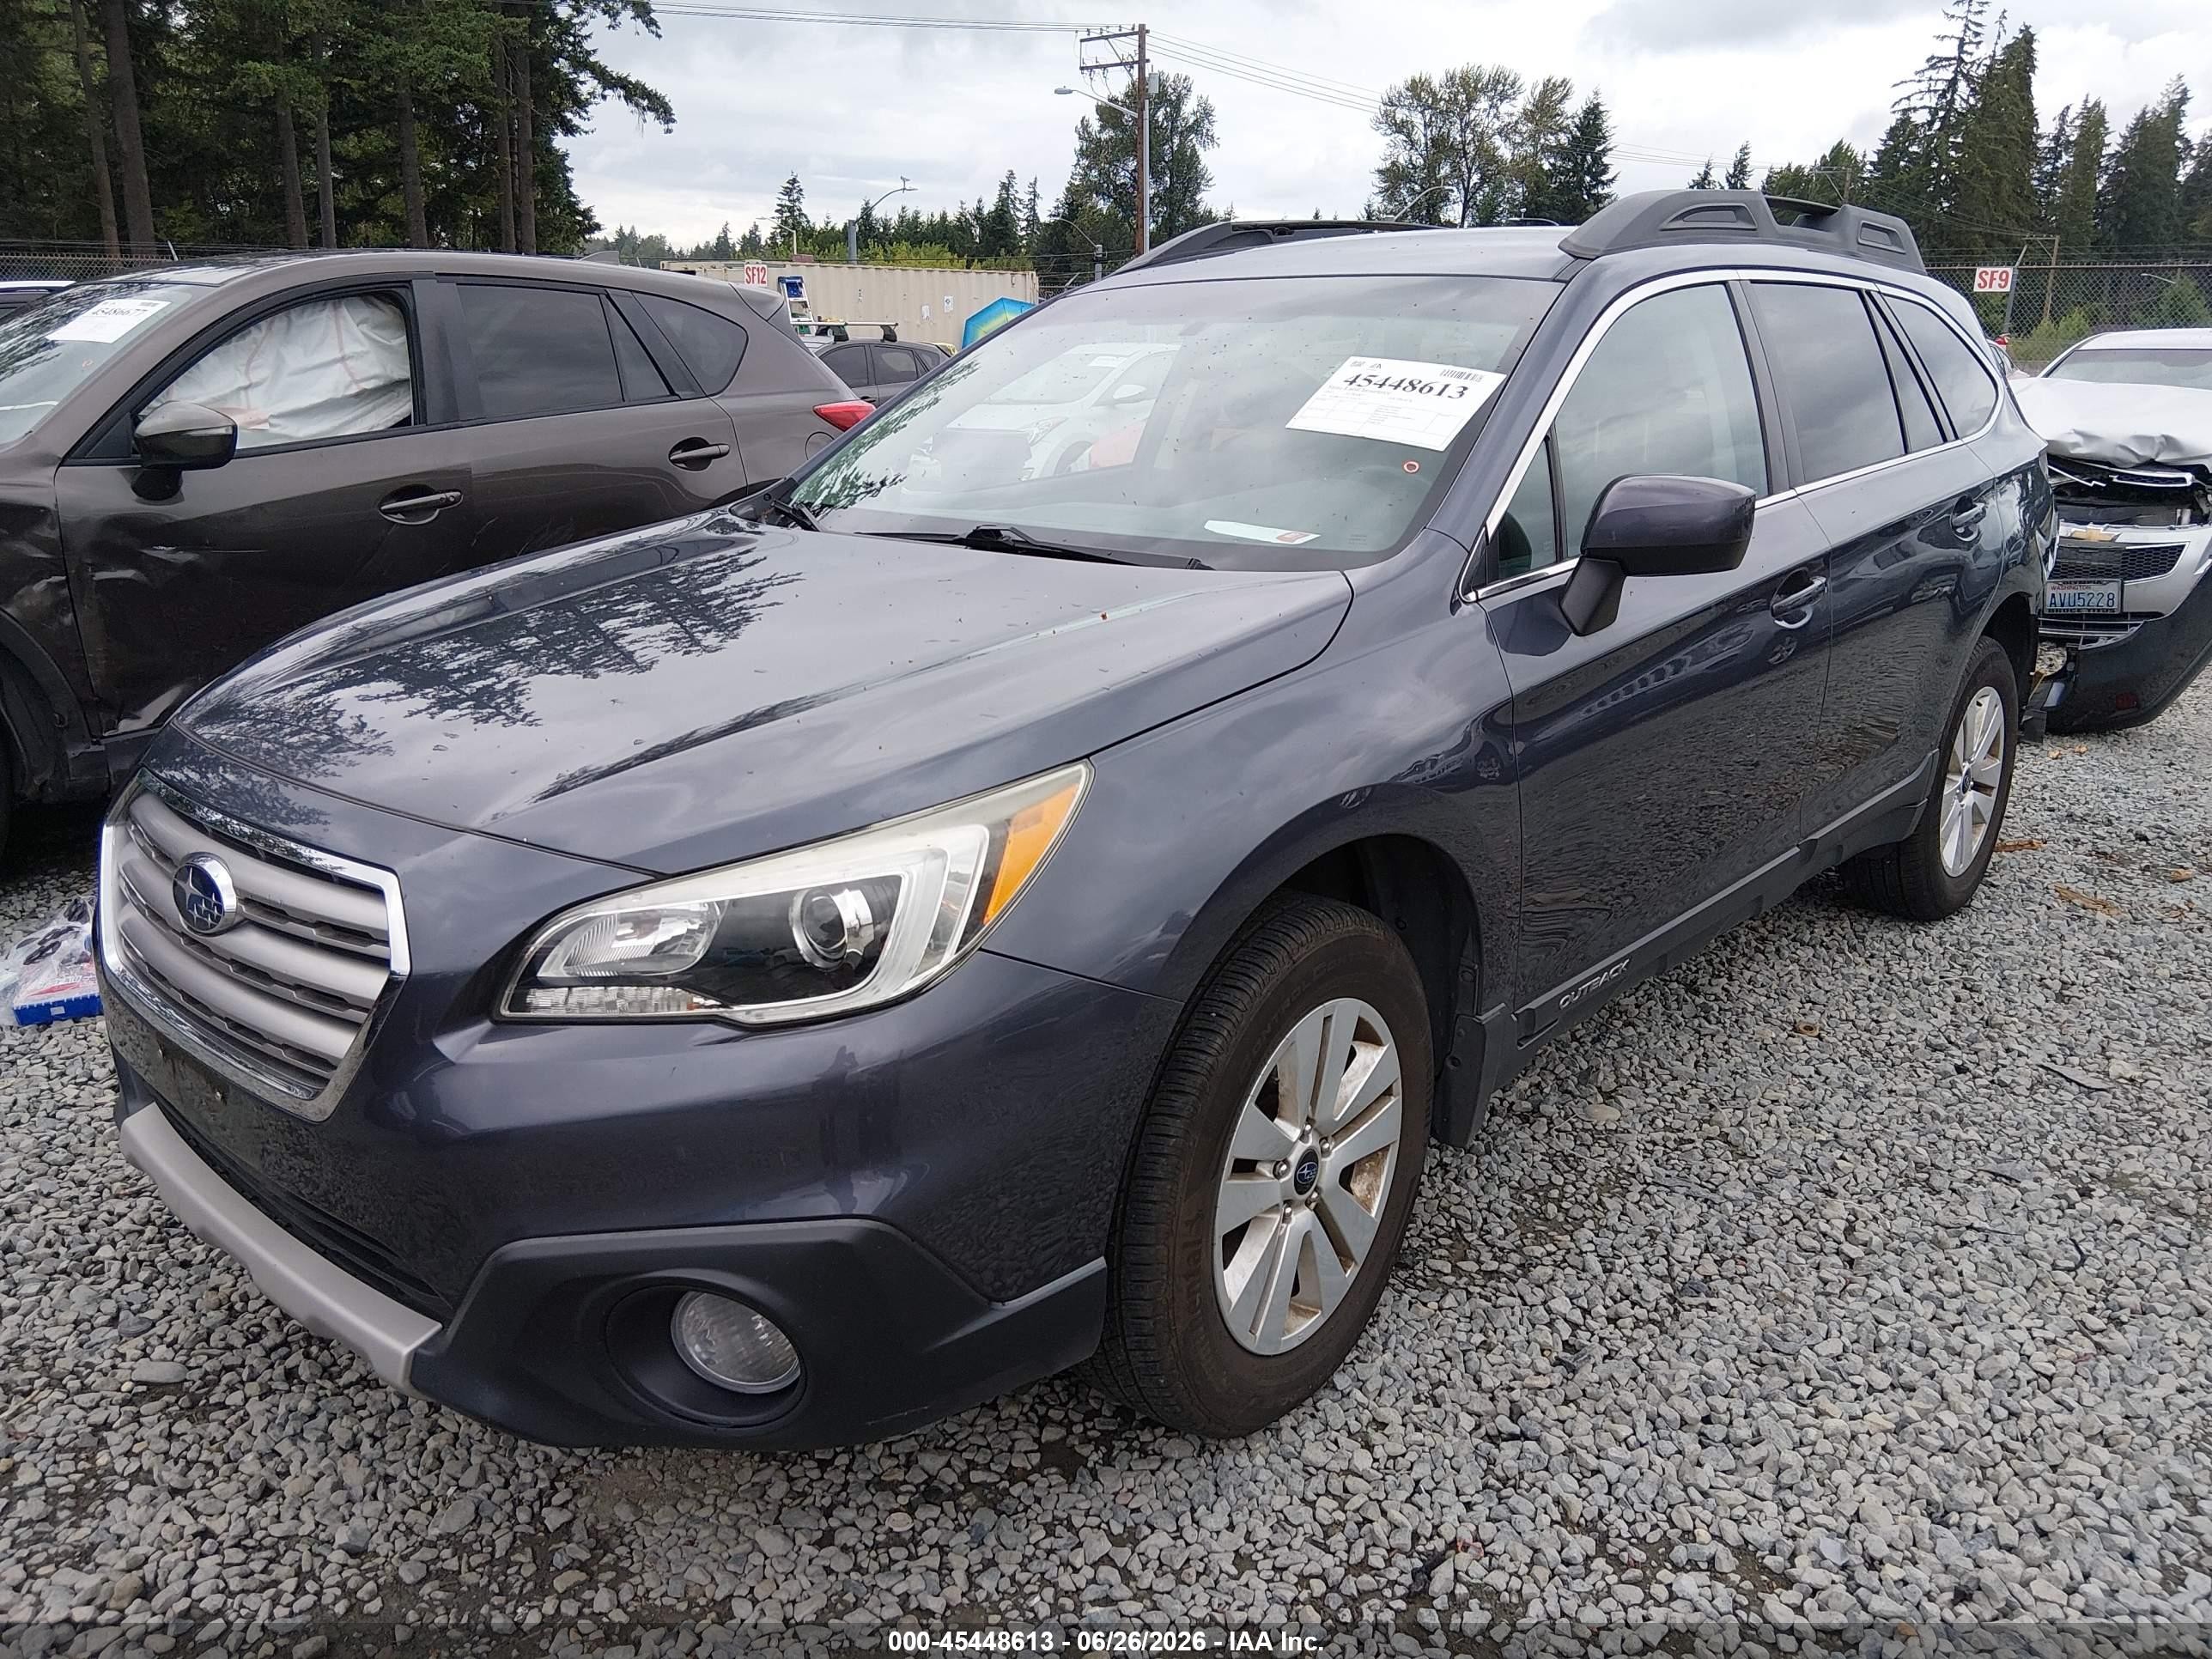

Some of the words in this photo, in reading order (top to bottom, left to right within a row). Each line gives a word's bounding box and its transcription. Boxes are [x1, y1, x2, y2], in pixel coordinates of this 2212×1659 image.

[745, 266, 767, 284] SF12
[1977, 270, 2010, 289] SF9
[1343, 374, 1469, 399] 45448613
[2049, 592, 2116, 608] AVU5228
[1559, 958, 1631, 1011] OUTBACK
